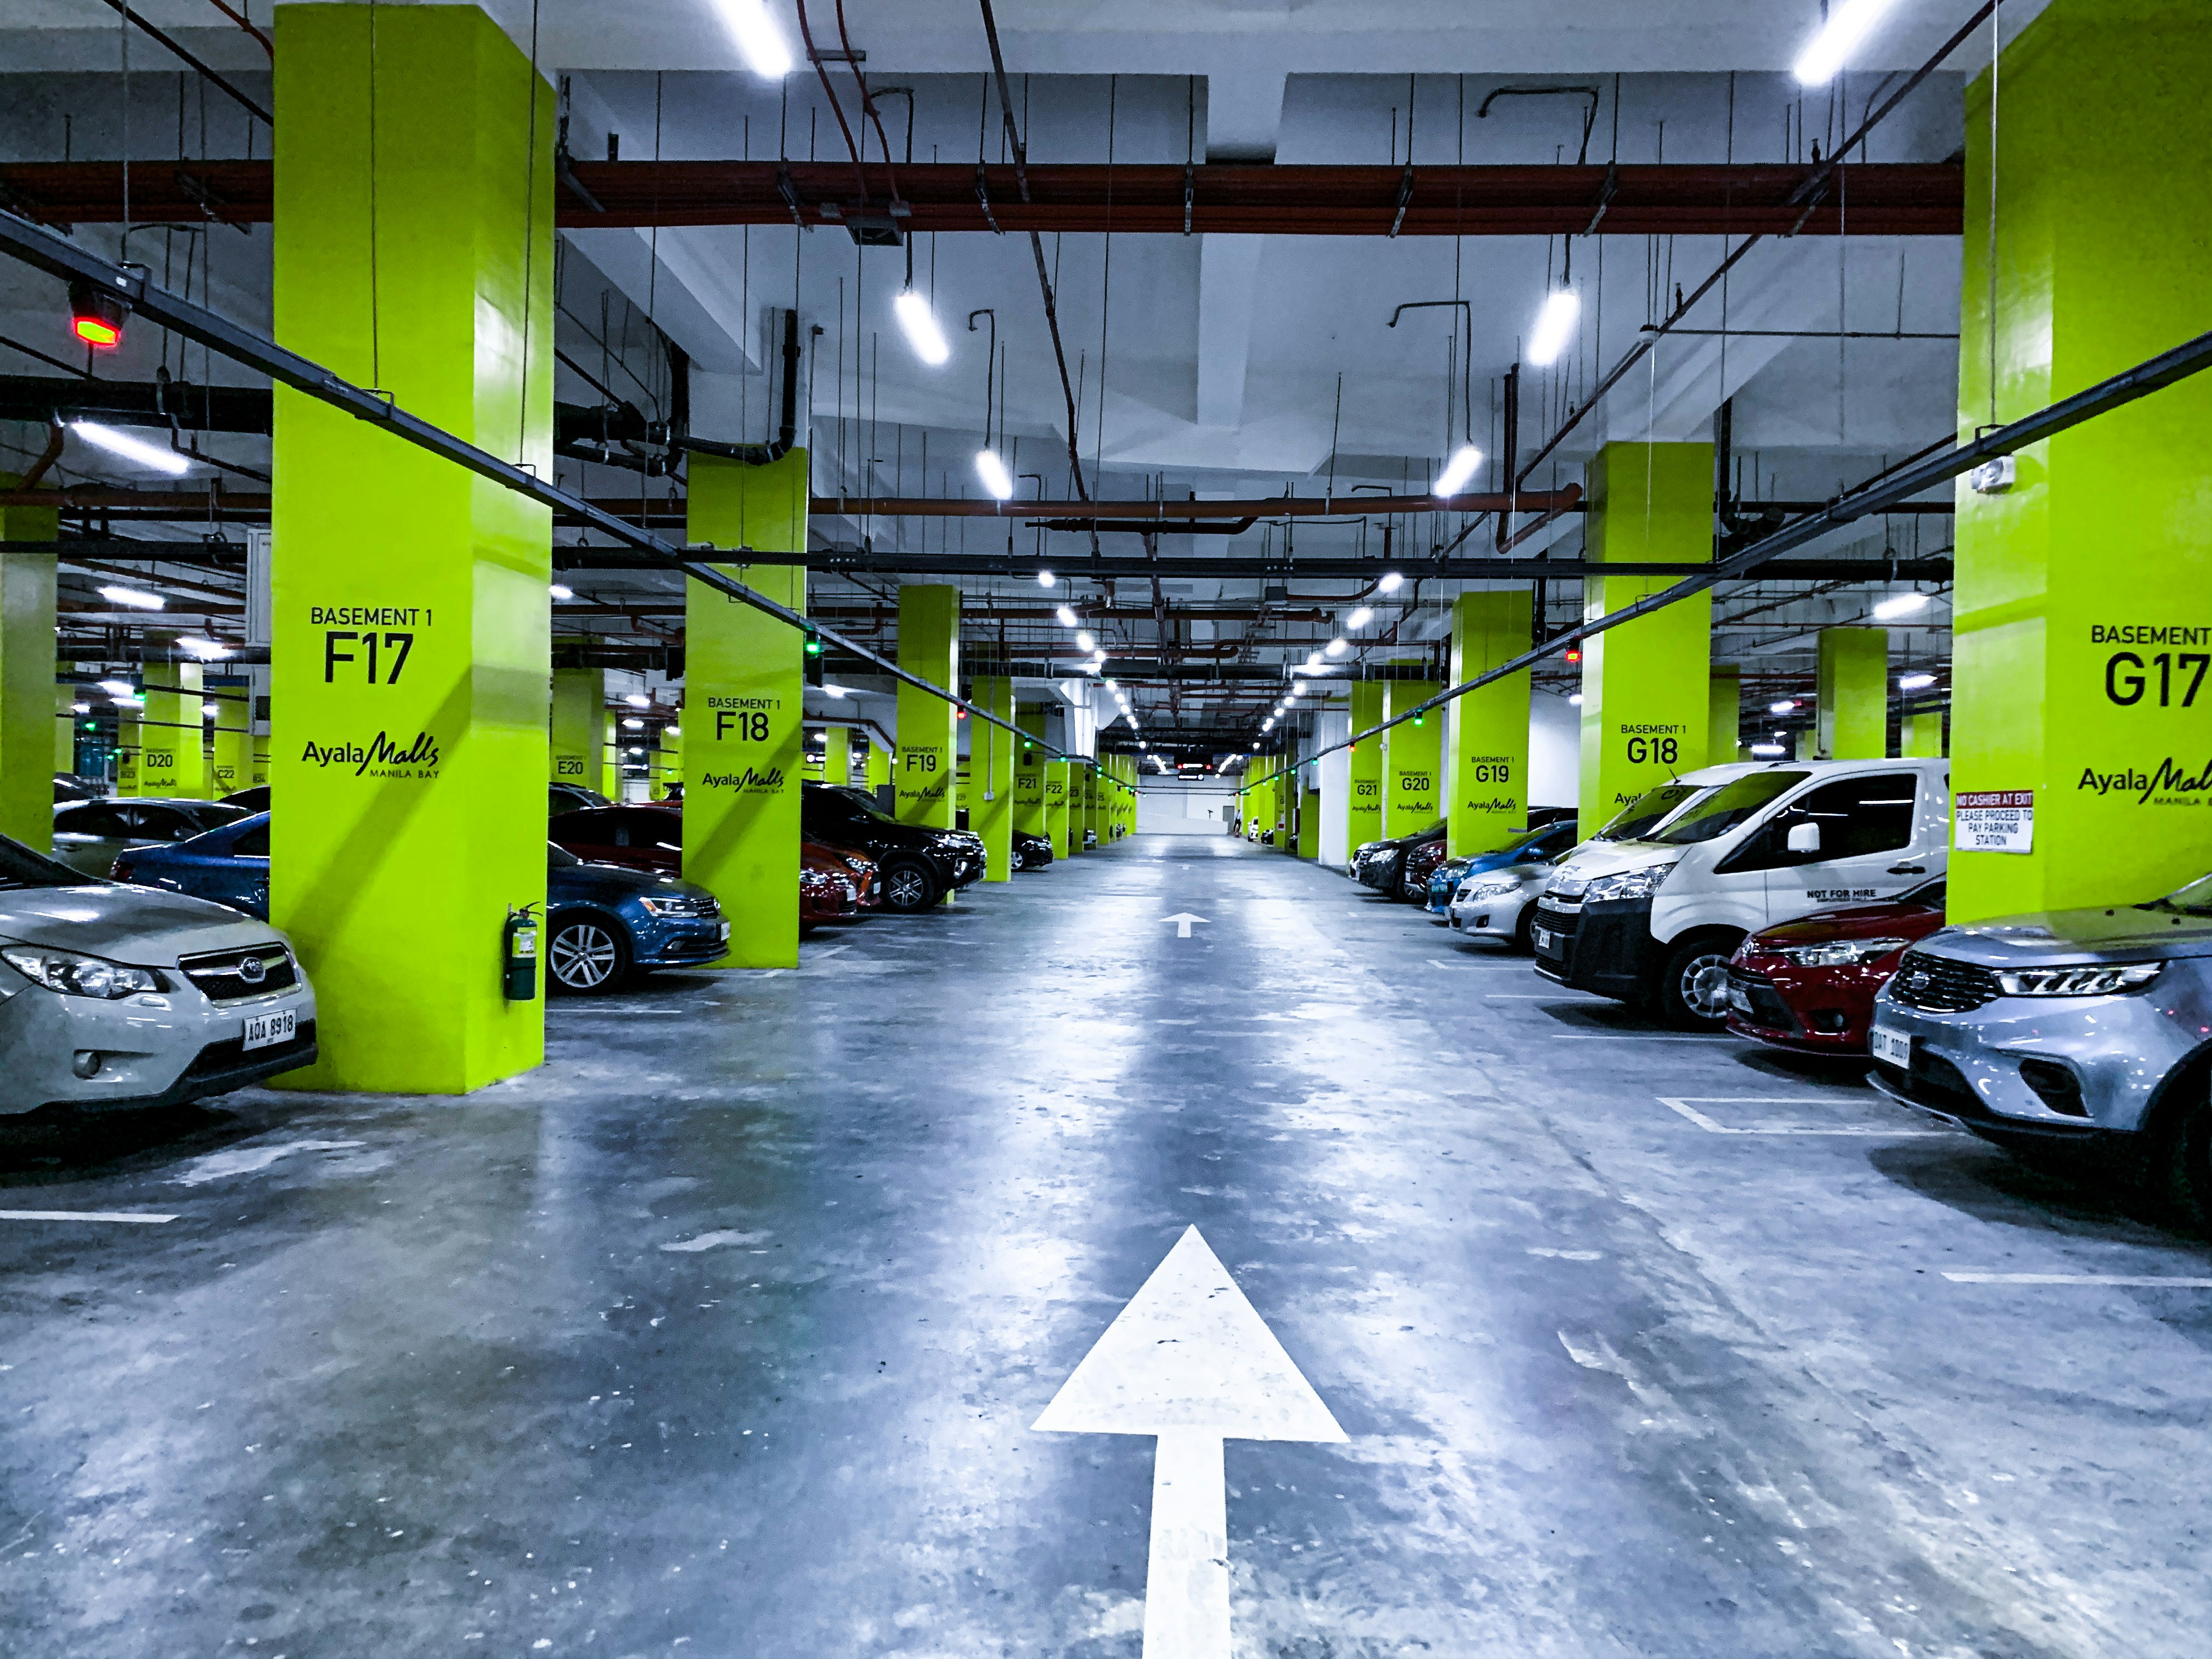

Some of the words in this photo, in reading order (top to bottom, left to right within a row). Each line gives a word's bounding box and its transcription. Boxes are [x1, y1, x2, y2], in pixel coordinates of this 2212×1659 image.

[311, 607, 420, 626] BASEMENT
[426, 608, 432, 627] 1
[2091, 625, 2211, 645] BASEMENT
[325, 631, 414, 685] F17
[2106, 651, 2211, 707] G17
[708, 697, 772, 709] BASEMENT
[776, 699, 780, 709] 1
[716, 711, 769, 741] F18
[1621, 724, 1679, 733] BASEMENT
[1682, 725, 1686, 734] 1
[301, 741, 364, 767] Ayala
[356, 731, 439, 776] Malls
[1627, 737, 1678, 764] G18
[147, 754, 173, 767] D20
[558, 760, 584, 775] E20
[906, 754, 936, 772] F19
[369, 769, 411, 778] MANILA
[418, 769, 439, 779] BAY
[702, 772, 740, 788] Ayala
[735, 767, 785, 793] Malls
[1476, 765, 1509, 783] G19
[2077, 768, 2147, 795] Ayala
[1018, 778, 1036, 789] F21
[1046, 785, 1062, 794] F22
[1357, 785, 1377, 795] G21
[1402, 777, 1430, 791] G20
[1467, 801, 1490, 810] Ayala
[1486, 797, 1516, 814] Malls
[1956, 795, 1967, 806] NO
[1968, 794, 2001, 806] CASHIER
[2002, 793, 2013, 805] AT
[2015, 793, 2033, 805] EXIT
[1956, 810, 1983, 821] PLEASE
[1985, 809, 2021, 821] PROCEED
[2023, 809, 2033, 821] TO
[1968, 822, 1982, 833] PAY
[1984, 822, 2019, 834] PARKING
[1976, 834, 2007, 845] STATION
[1807, 890, 1827, 898] NOT
[1830, 889, 1850, 898] FOR
[1853, 889, 1876, 897] HIRE
[270, 1014, 294, 1036] 8918
